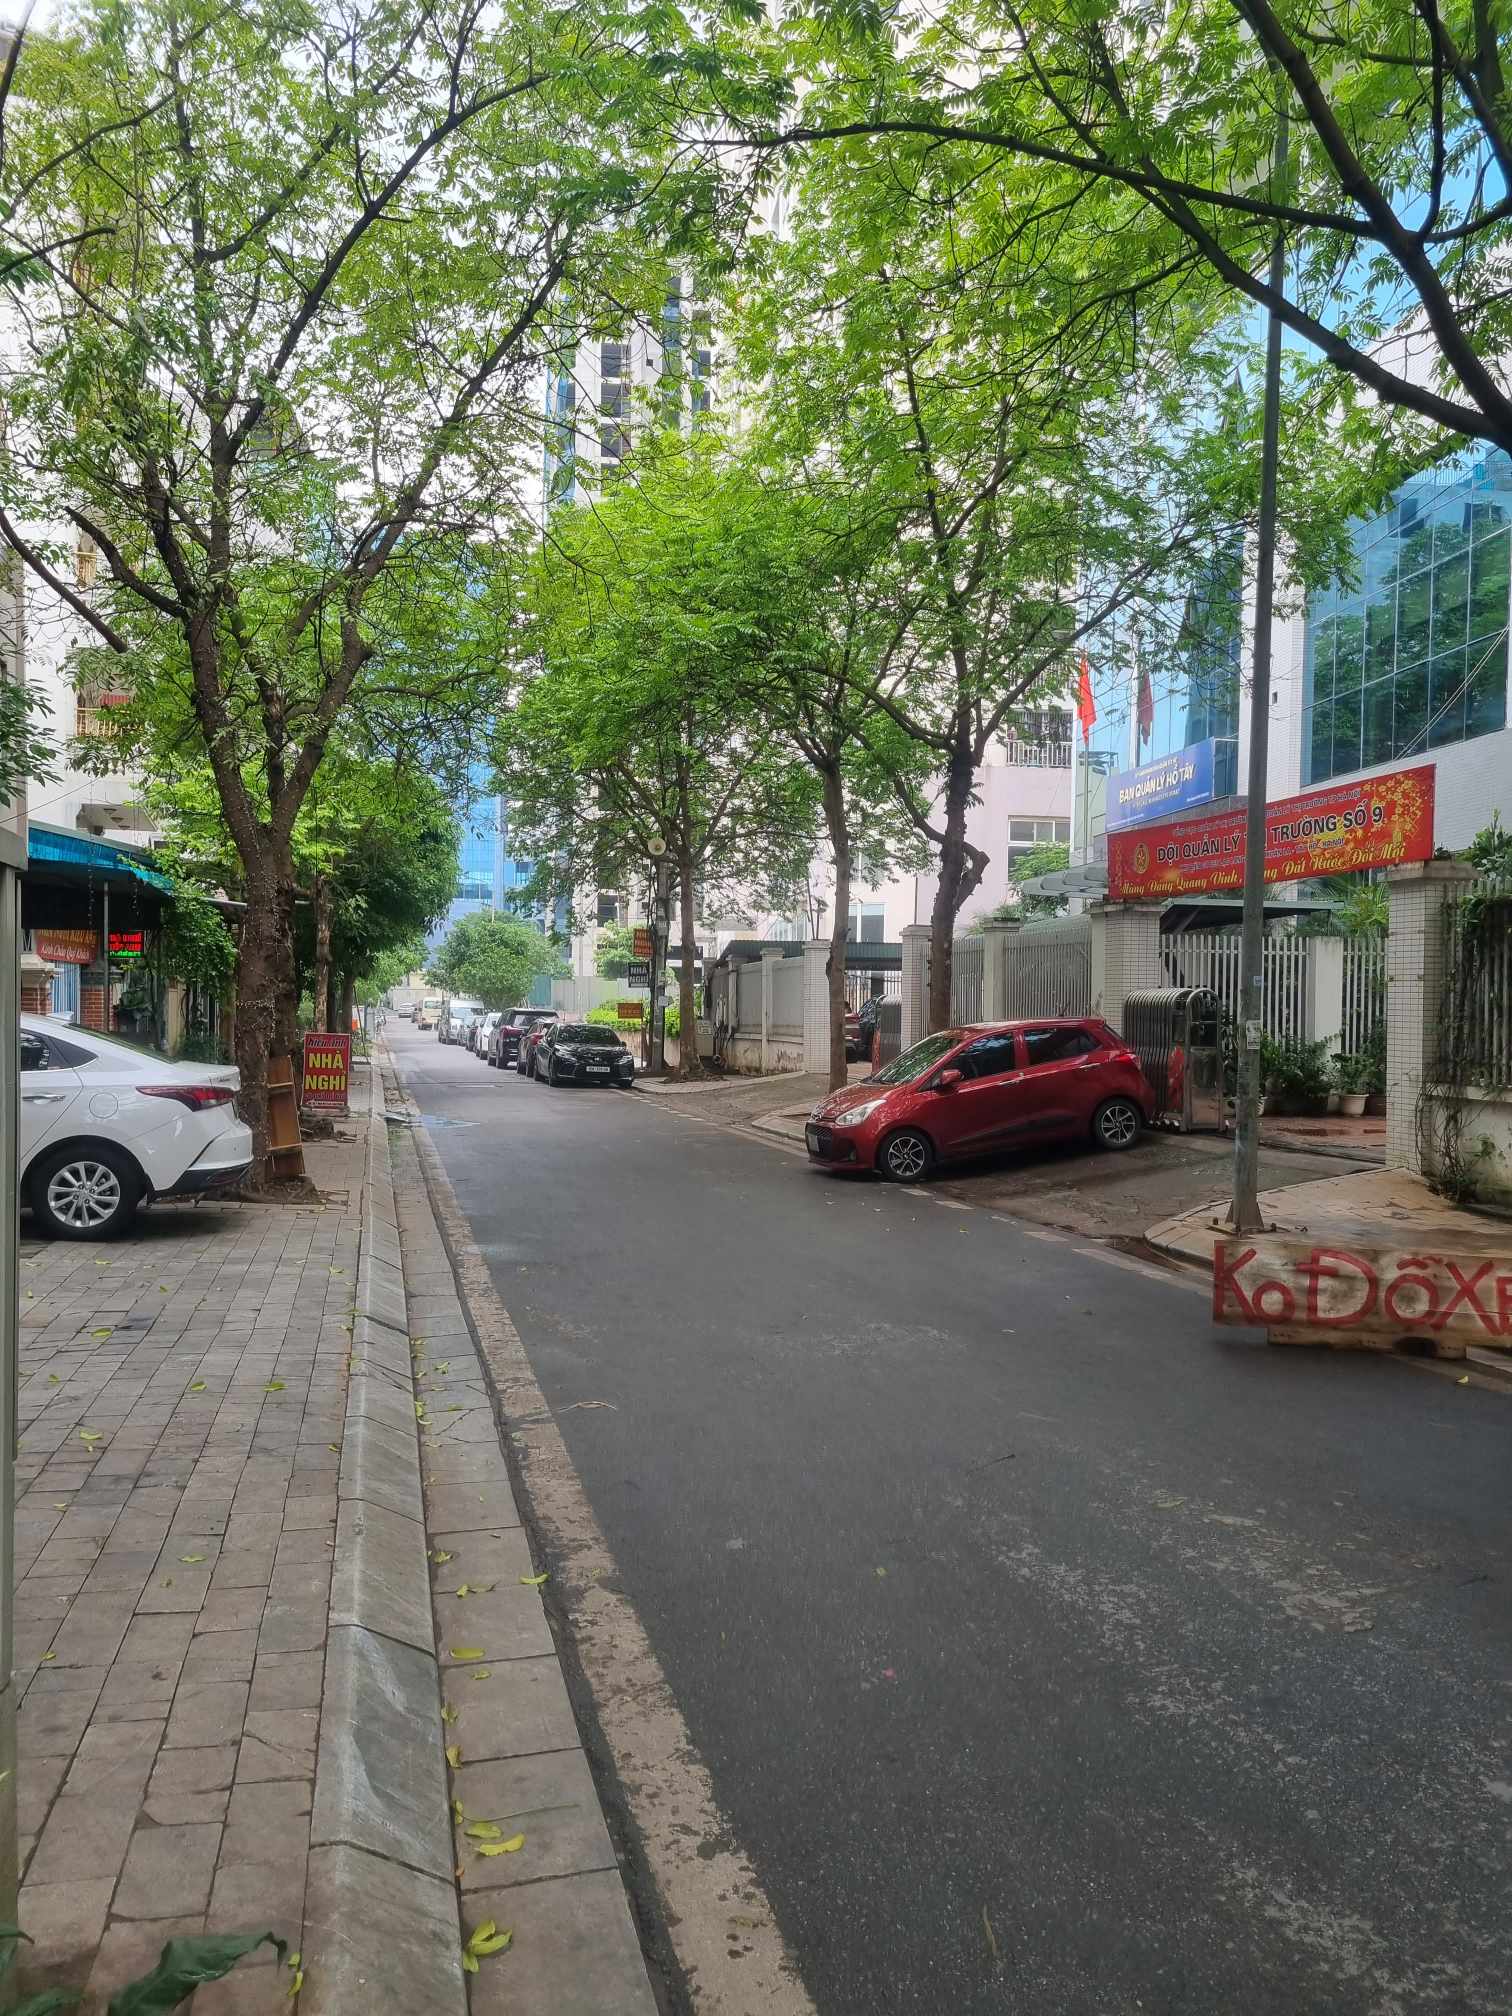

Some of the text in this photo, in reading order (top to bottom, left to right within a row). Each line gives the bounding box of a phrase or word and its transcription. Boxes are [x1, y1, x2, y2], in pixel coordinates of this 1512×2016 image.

[1119, 786, 1136, 804] BAN
[1156, 771, 1166, 791] LÝ
[1182, 833, 1221, 859] QUẢN
[1223, 829, 1241, 854] LÝ
[1271, 814, 1337, 844] TRƯỜNG
[1343, 798, 1369, 831] SỐ
[1372, 804, 1384, 824] 9
[304, 1070, 347, 1091] NGHỈ
